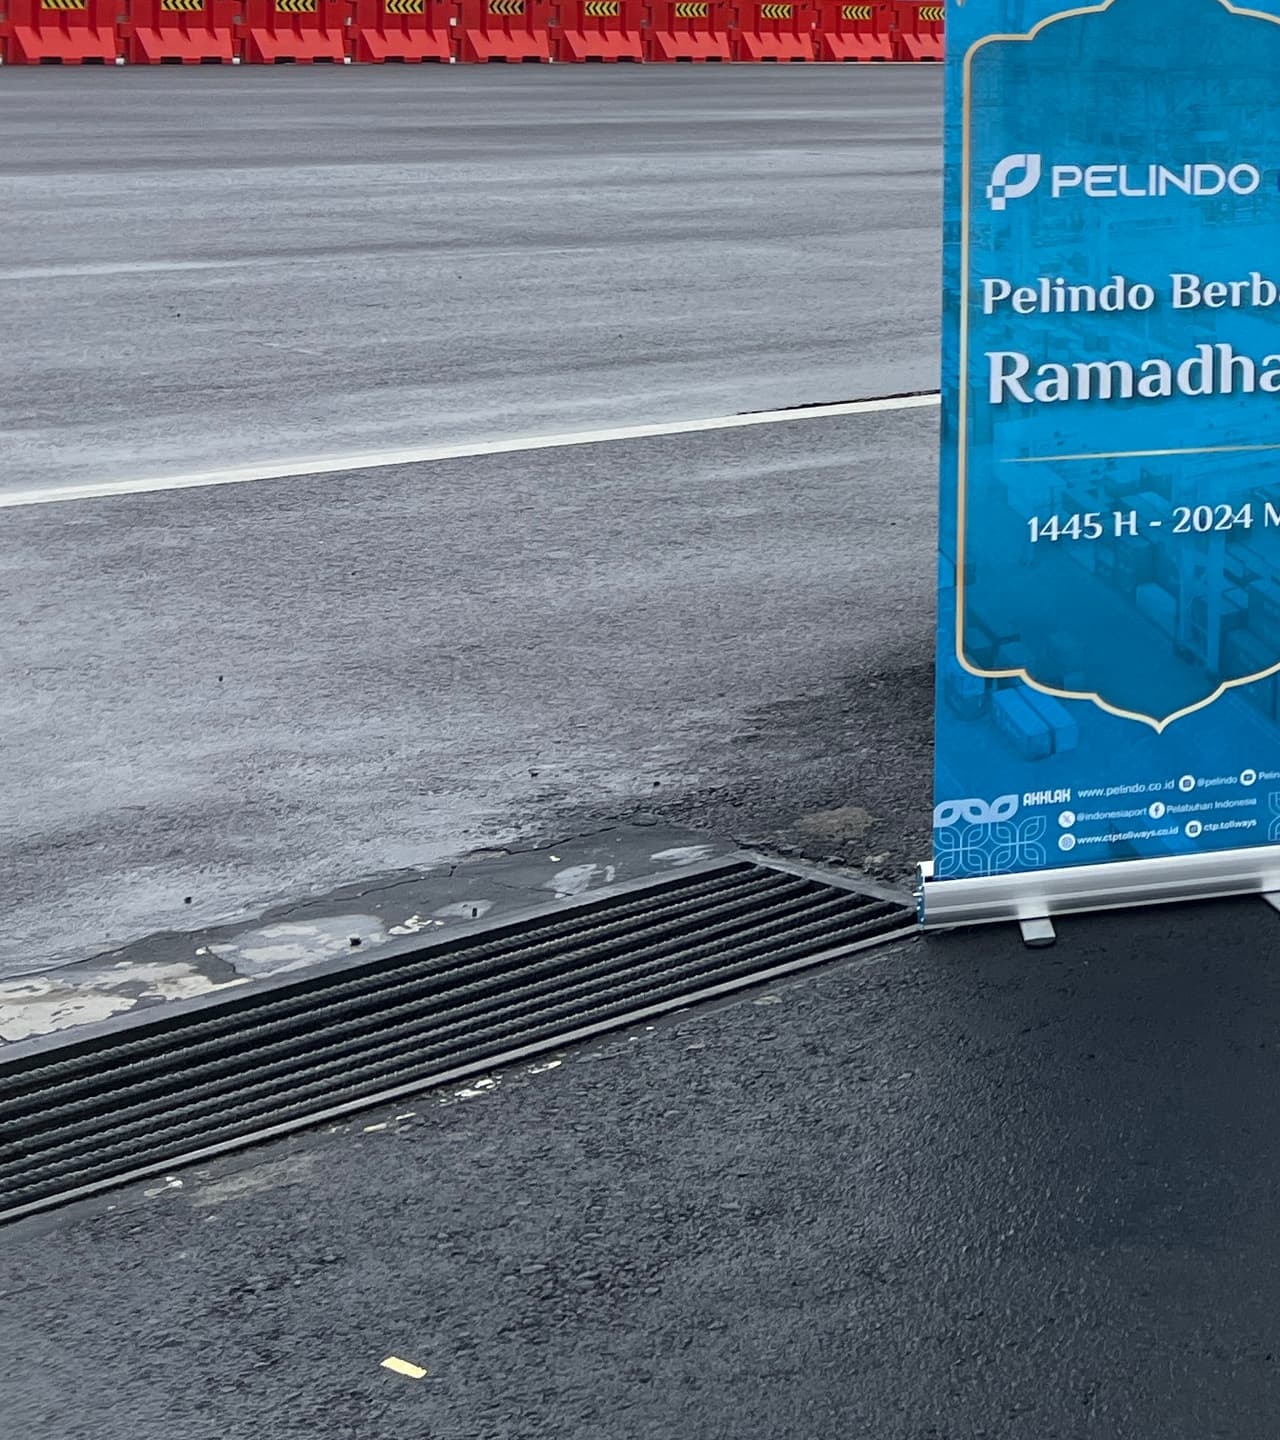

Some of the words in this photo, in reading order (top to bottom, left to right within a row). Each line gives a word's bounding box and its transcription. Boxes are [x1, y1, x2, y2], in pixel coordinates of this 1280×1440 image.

[1052, 162, 1260, 198] PELINDO
[980, 274, 1155, 315] Pelindo
[1026, 511, 1104, 543] 1445
[1112, 510, 1139, 537] H
[1172, 502, 1254, 534] 2024
[1077, 779, 1175, 798] www.pelindo.co.id
[1214, 797, 1257, 810] Indonesia
